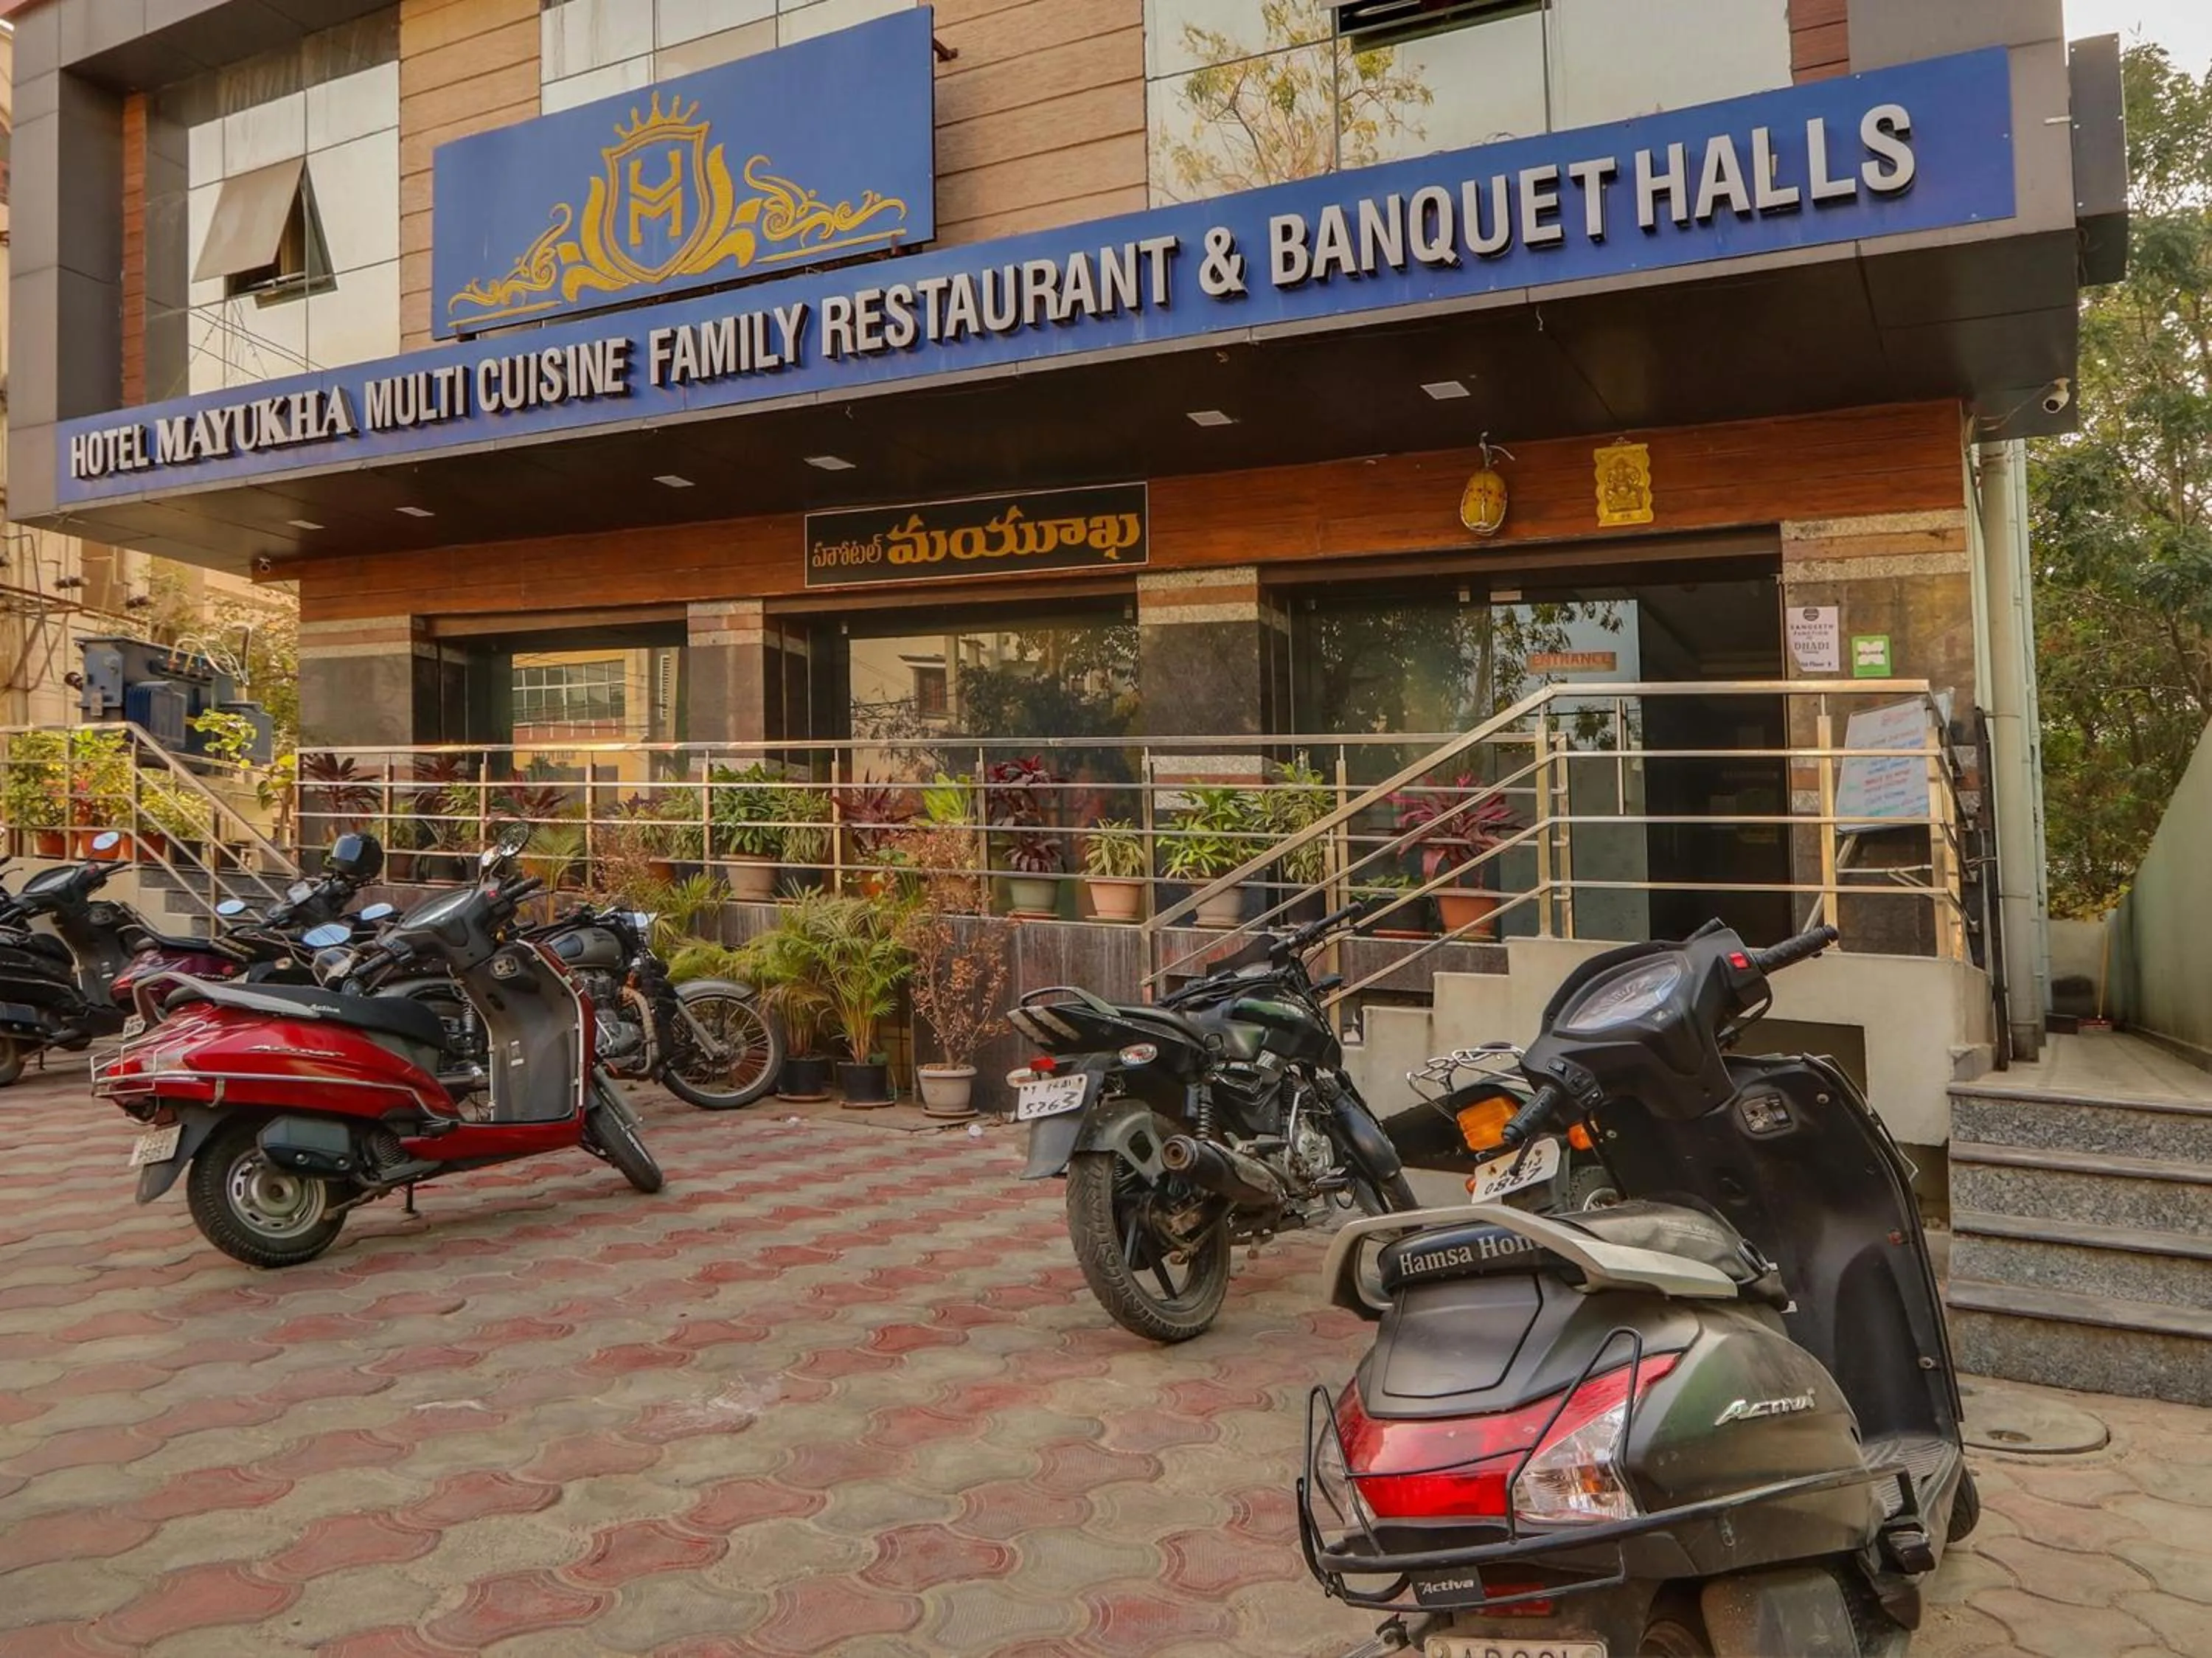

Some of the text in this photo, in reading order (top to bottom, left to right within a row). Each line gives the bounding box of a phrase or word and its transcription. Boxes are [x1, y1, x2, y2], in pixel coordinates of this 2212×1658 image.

[71, 103, 1916, 479] HOTEL MAYUKHA MULTI CUISINE FAMILY RESTAURANT & BANQUET HALLS
[1399, 1234, 1544, 1277] Hamsa Hon
[1422, 1578, 1474, 1595] Activa
